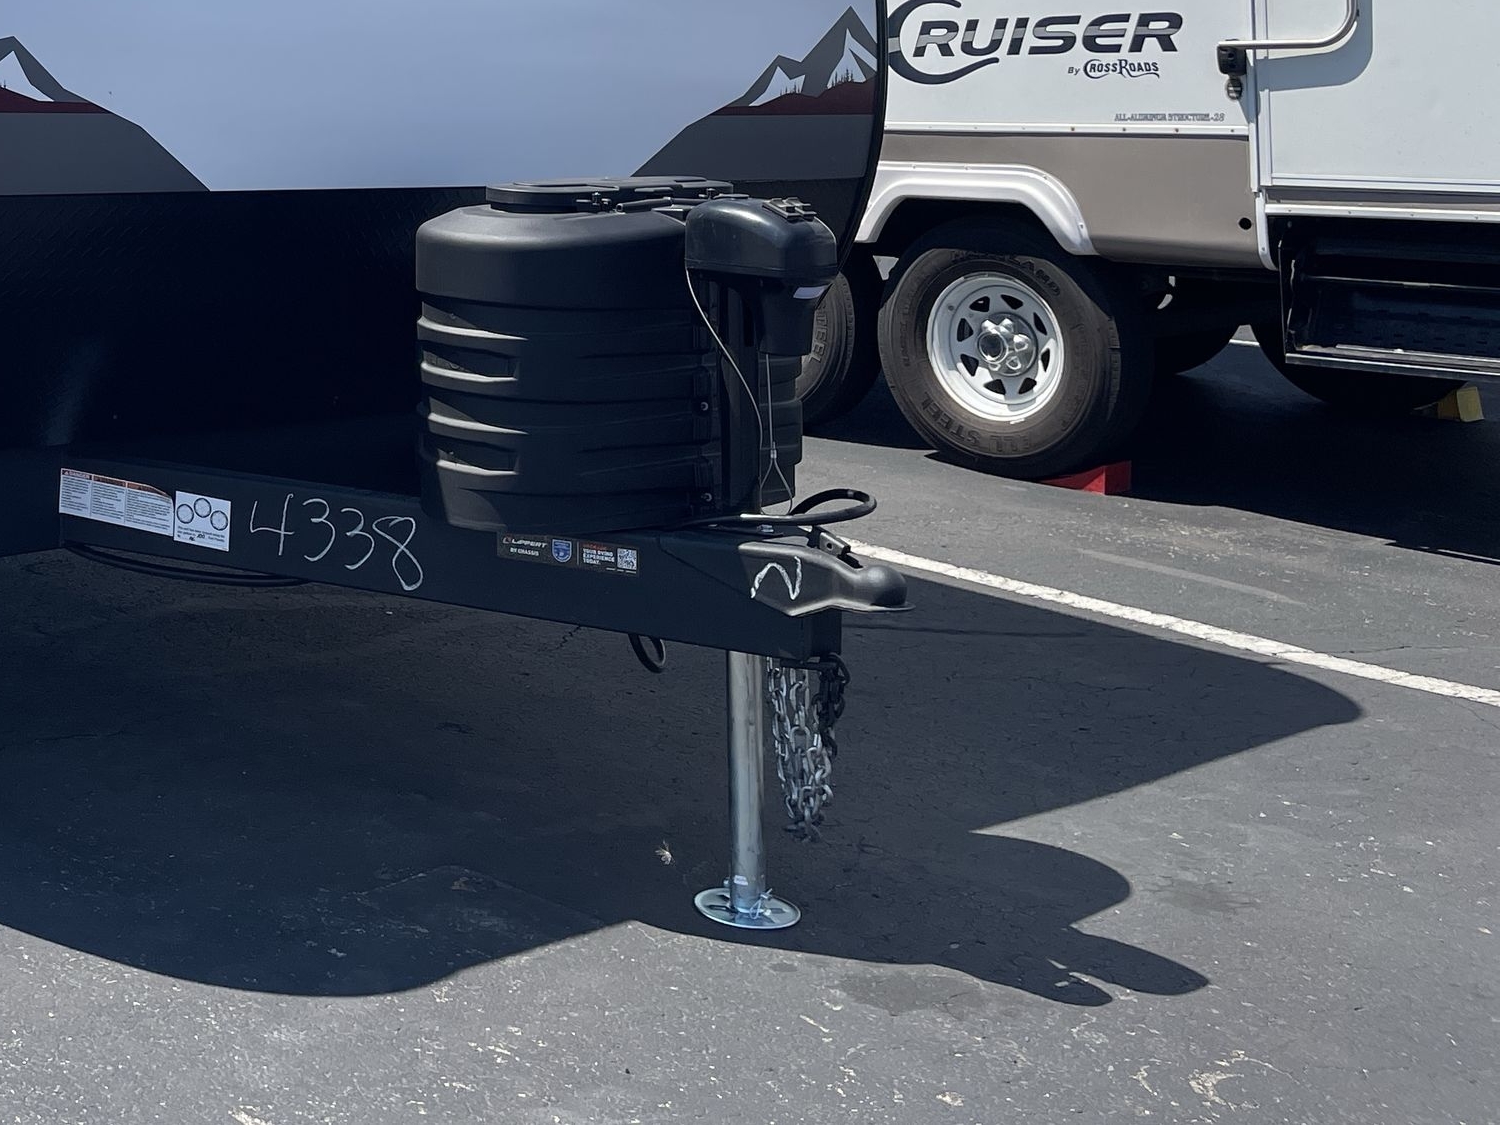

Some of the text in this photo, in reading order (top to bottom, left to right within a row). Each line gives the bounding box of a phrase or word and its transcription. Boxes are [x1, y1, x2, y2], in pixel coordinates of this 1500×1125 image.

[249, 493, 424, 592] 4338
[511, 537, 547, 549] LIPPERT
[582, 552, 615, 563] EXPERIENCE
